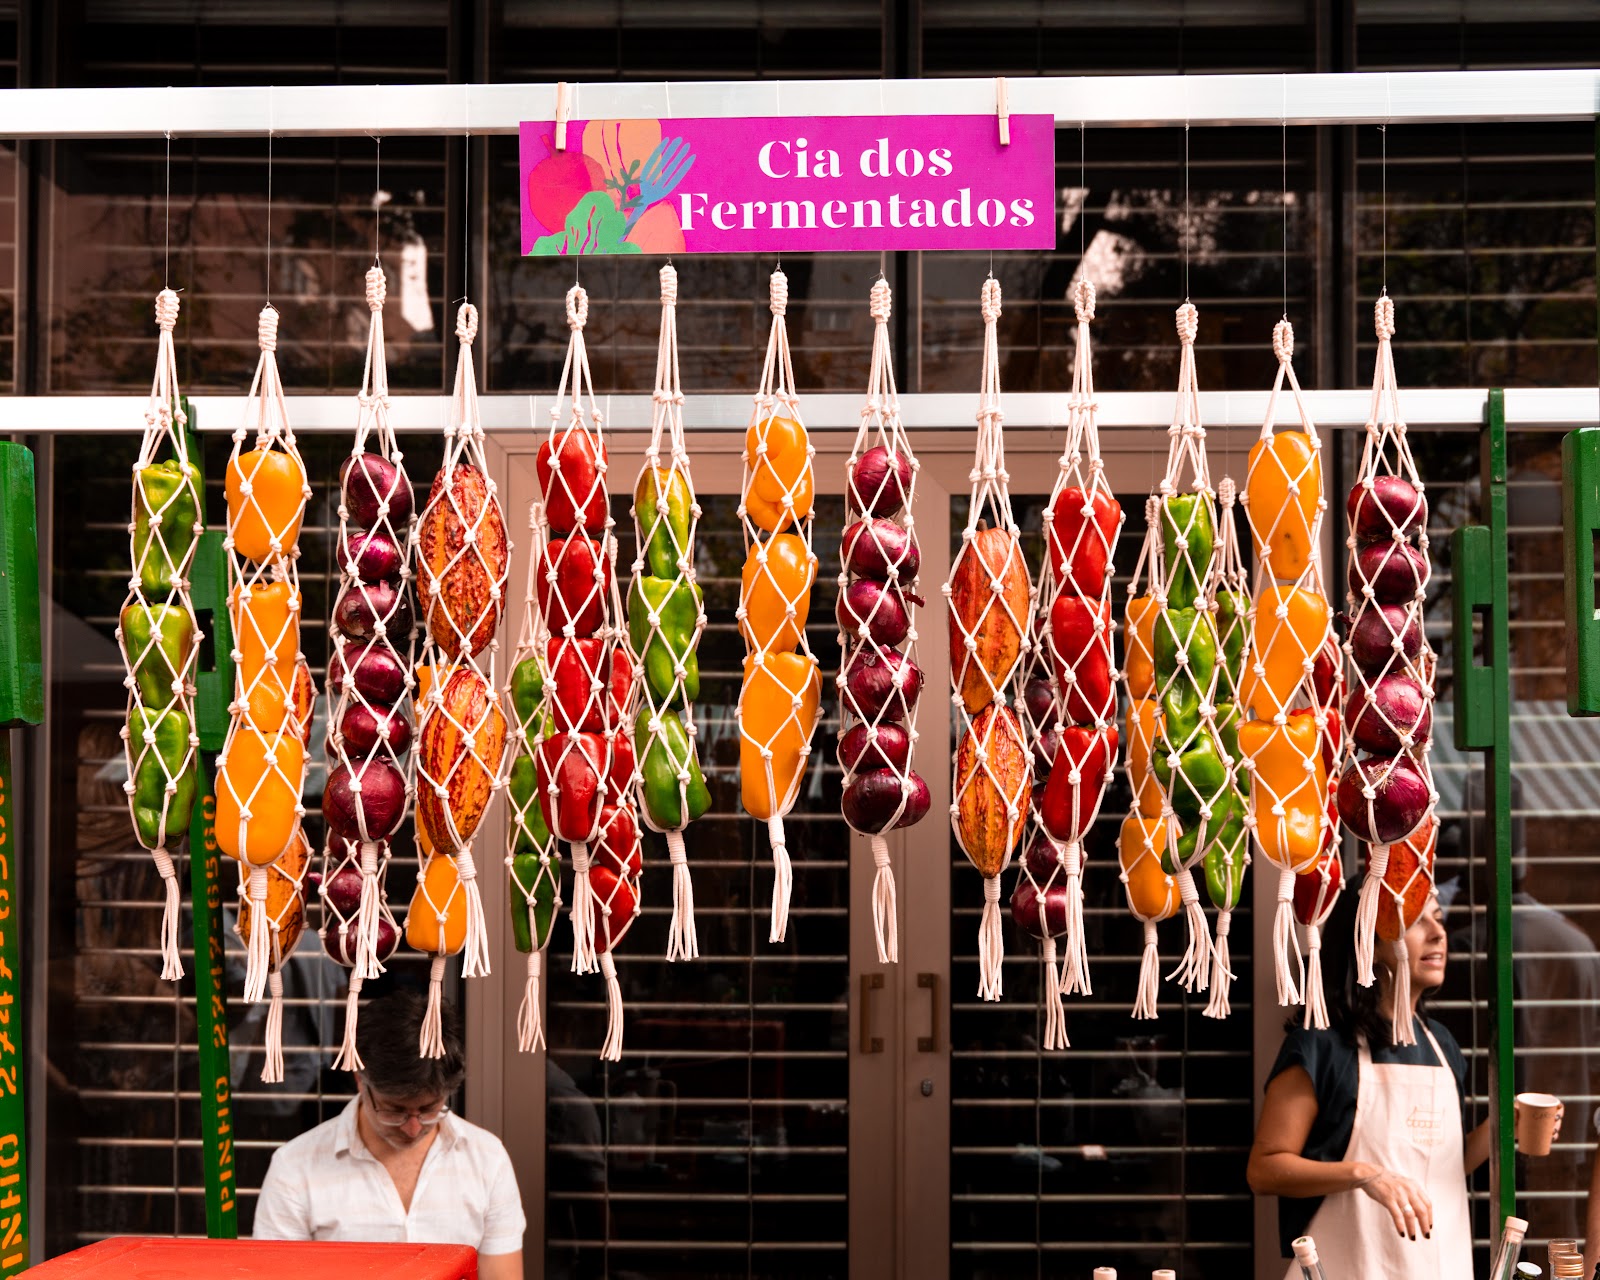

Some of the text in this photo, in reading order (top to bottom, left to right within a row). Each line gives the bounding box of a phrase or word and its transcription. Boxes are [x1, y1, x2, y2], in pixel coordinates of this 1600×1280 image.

[758, 137, 953, 179] Cia dos
[679, 187, 1035, 230] Fermentados
[215, 1076, 235, 1213] PINHO
[0, 1134, 23, 1280] INHO
